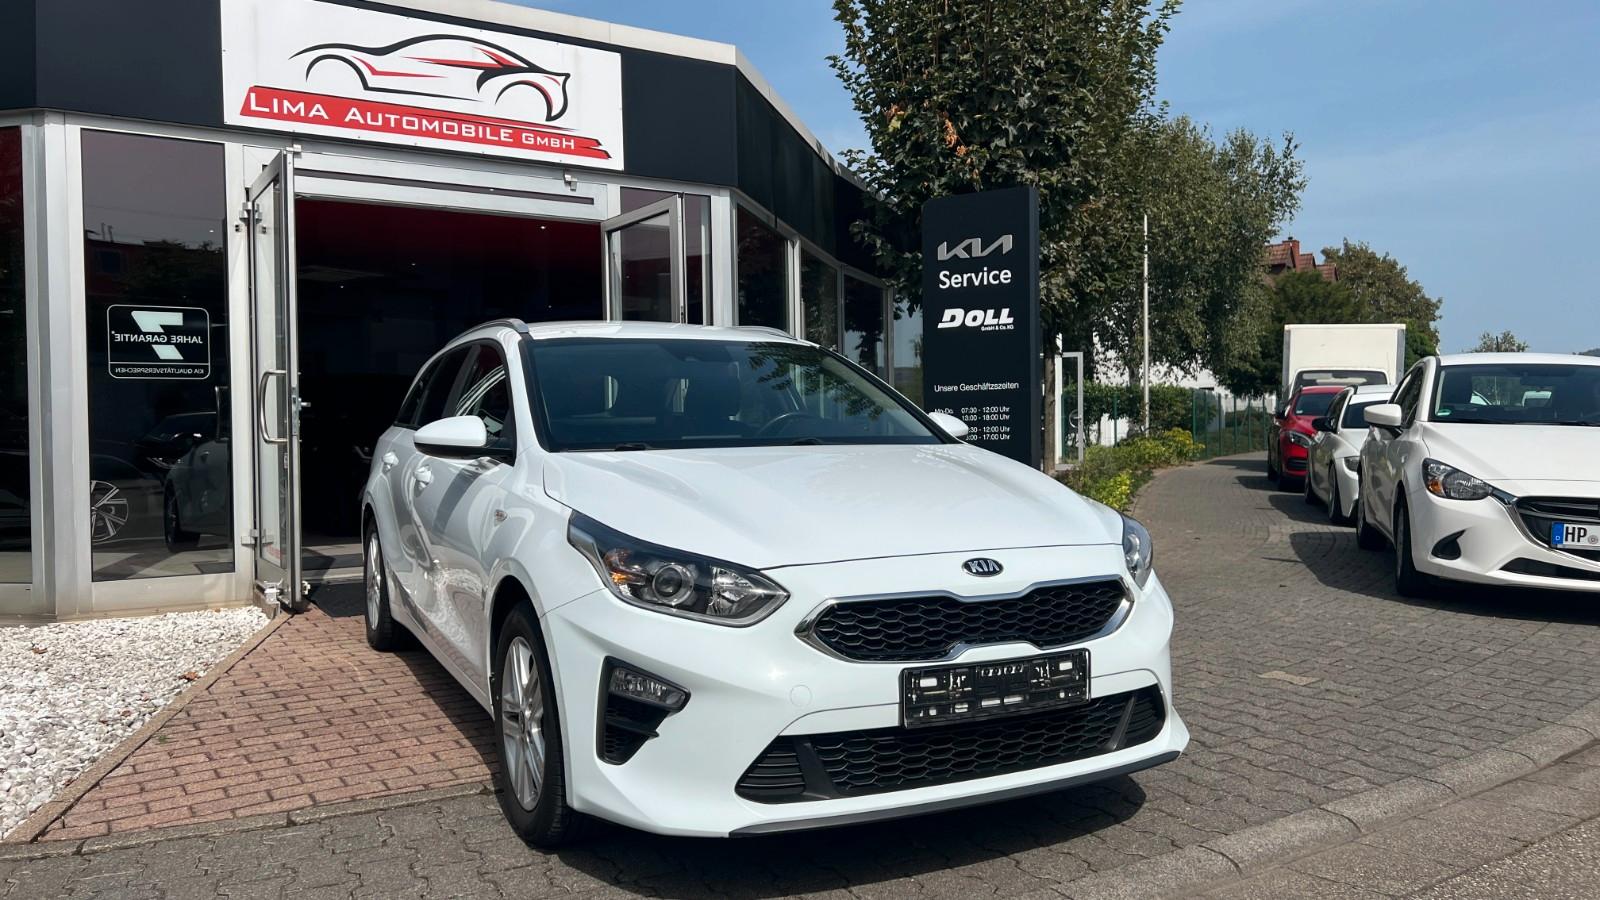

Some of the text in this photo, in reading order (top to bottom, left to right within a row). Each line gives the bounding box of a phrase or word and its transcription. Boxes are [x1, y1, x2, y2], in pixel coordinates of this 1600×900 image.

[249, 92, 329, 120] LIMA
[344, 106, 514, 142] AUTOMOBILE
[939, 266, 1012, 289] Service
[937, 307, 1014, 329] DOLL
[934, 384, 958, 392] Unsere
[1564, 526, 1588, 543] HP
[967, 559, 1001, 573] KIA
